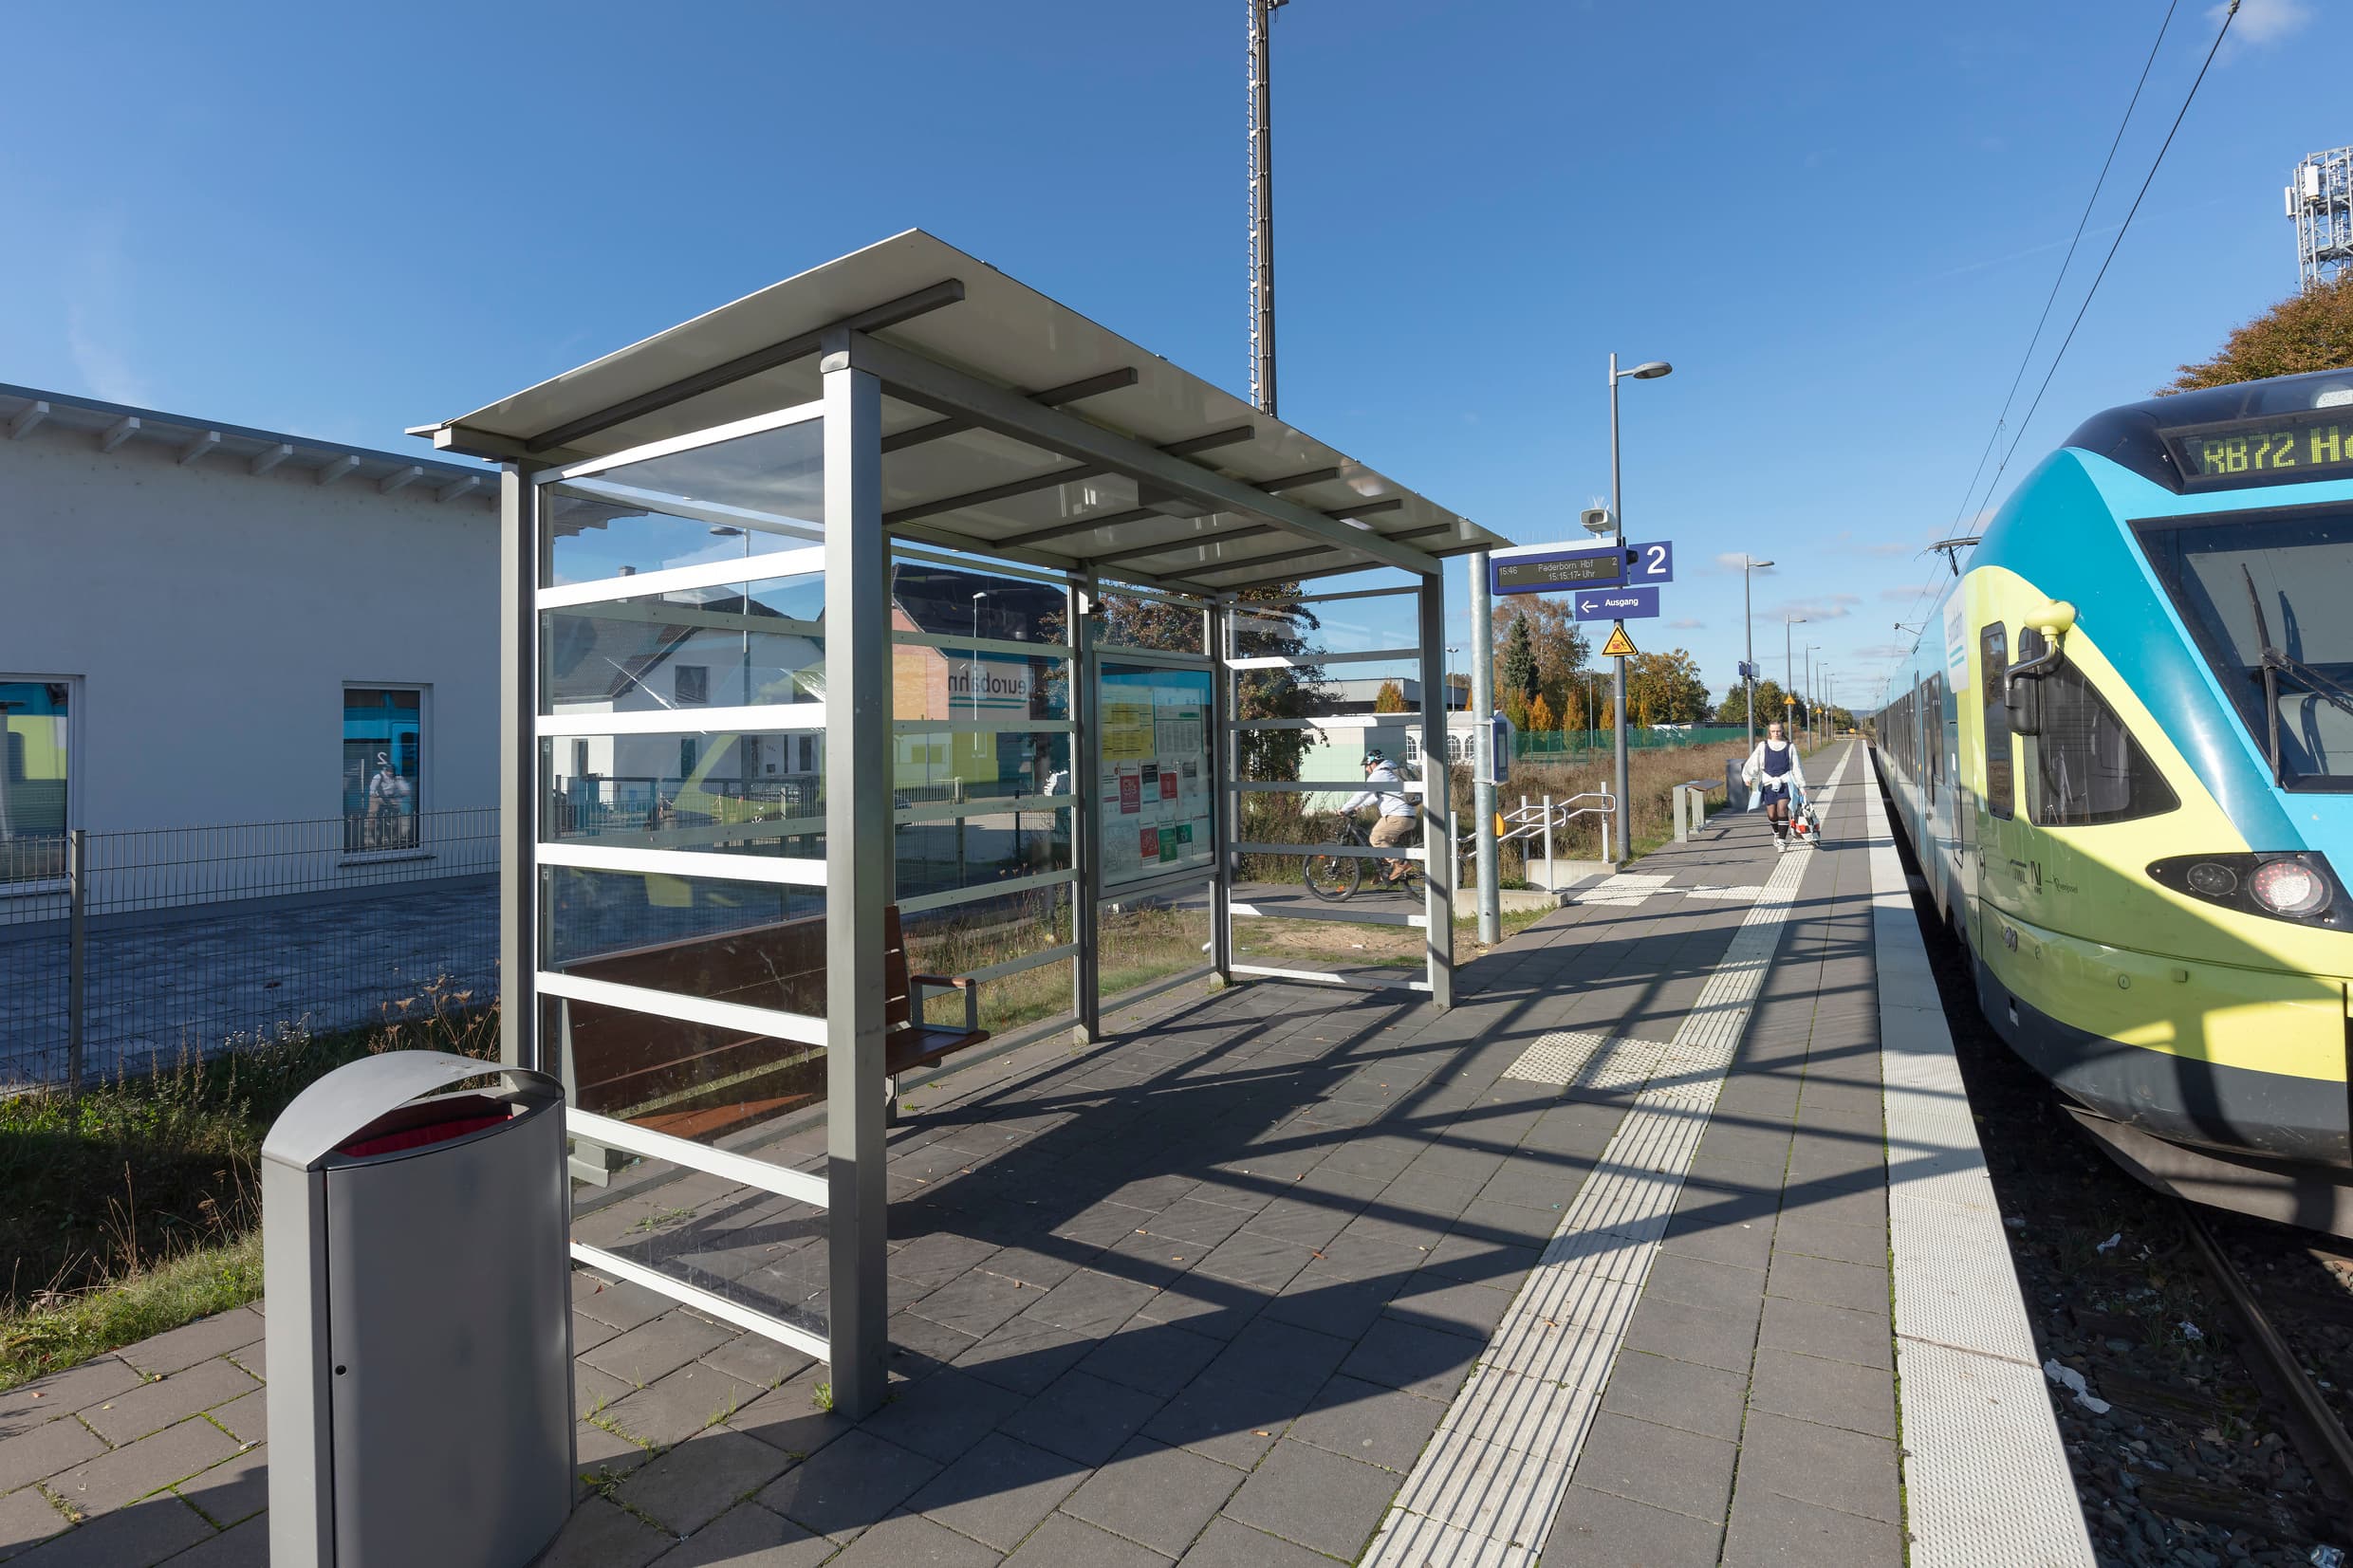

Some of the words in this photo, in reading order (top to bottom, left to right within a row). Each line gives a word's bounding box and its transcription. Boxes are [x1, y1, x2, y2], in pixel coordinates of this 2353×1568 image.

[2203, 432, 2295, 474] RB72
[1538, 562, 1577, 572] Paderborn
[1580, 559, 1594, 568] Hbf
[1611, 557, 1618, 566] 2
[1646, 545, 1667, 575] 2
[1583, 570, 1595, 579] Uhr
[1604, 599, 1640, 607] Ausgang
